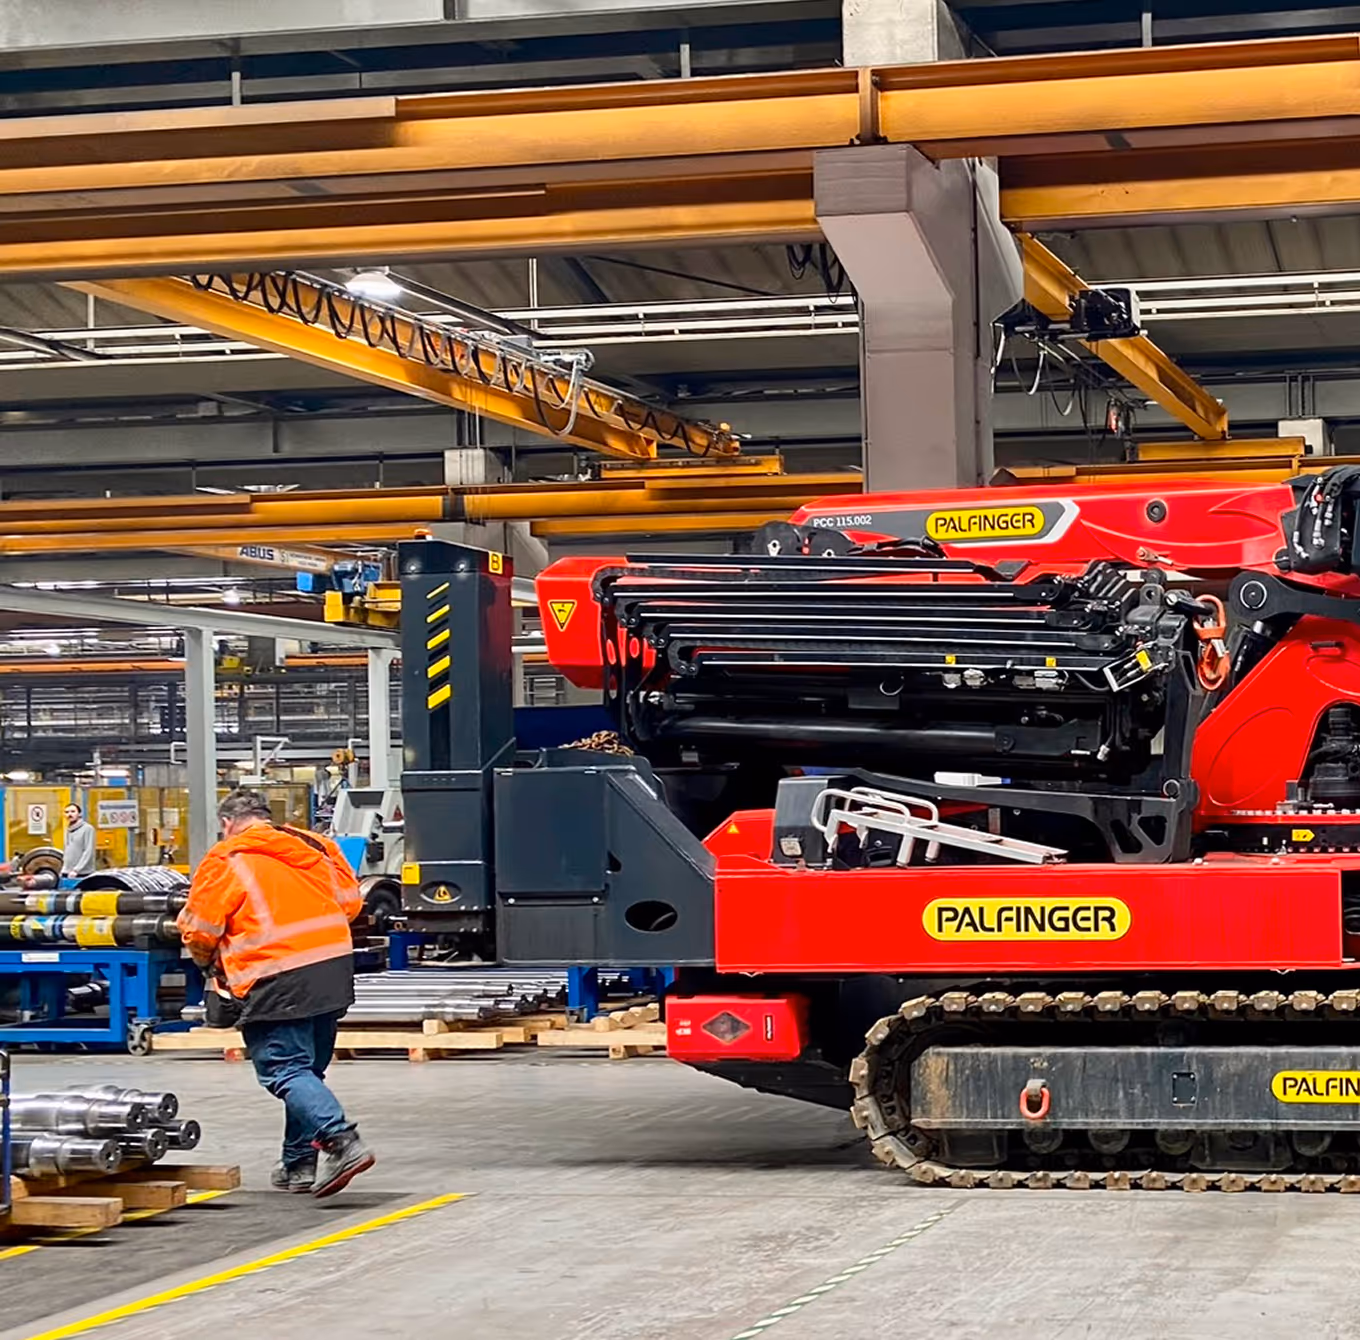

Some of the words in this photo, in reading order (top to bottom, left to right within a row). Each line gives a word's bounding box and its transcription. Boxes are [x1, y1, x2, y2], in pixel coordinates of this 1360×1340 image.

[813, 518, 834, 528] PCC
[836, 515, 872, 527] 115.002
[935, 512, 1036, 534] PALFINGER
[239, 545, 275, 561] ABUS
[491, 553, 500, 572] B
[937, 905, 1117, 933] PALFINGER
